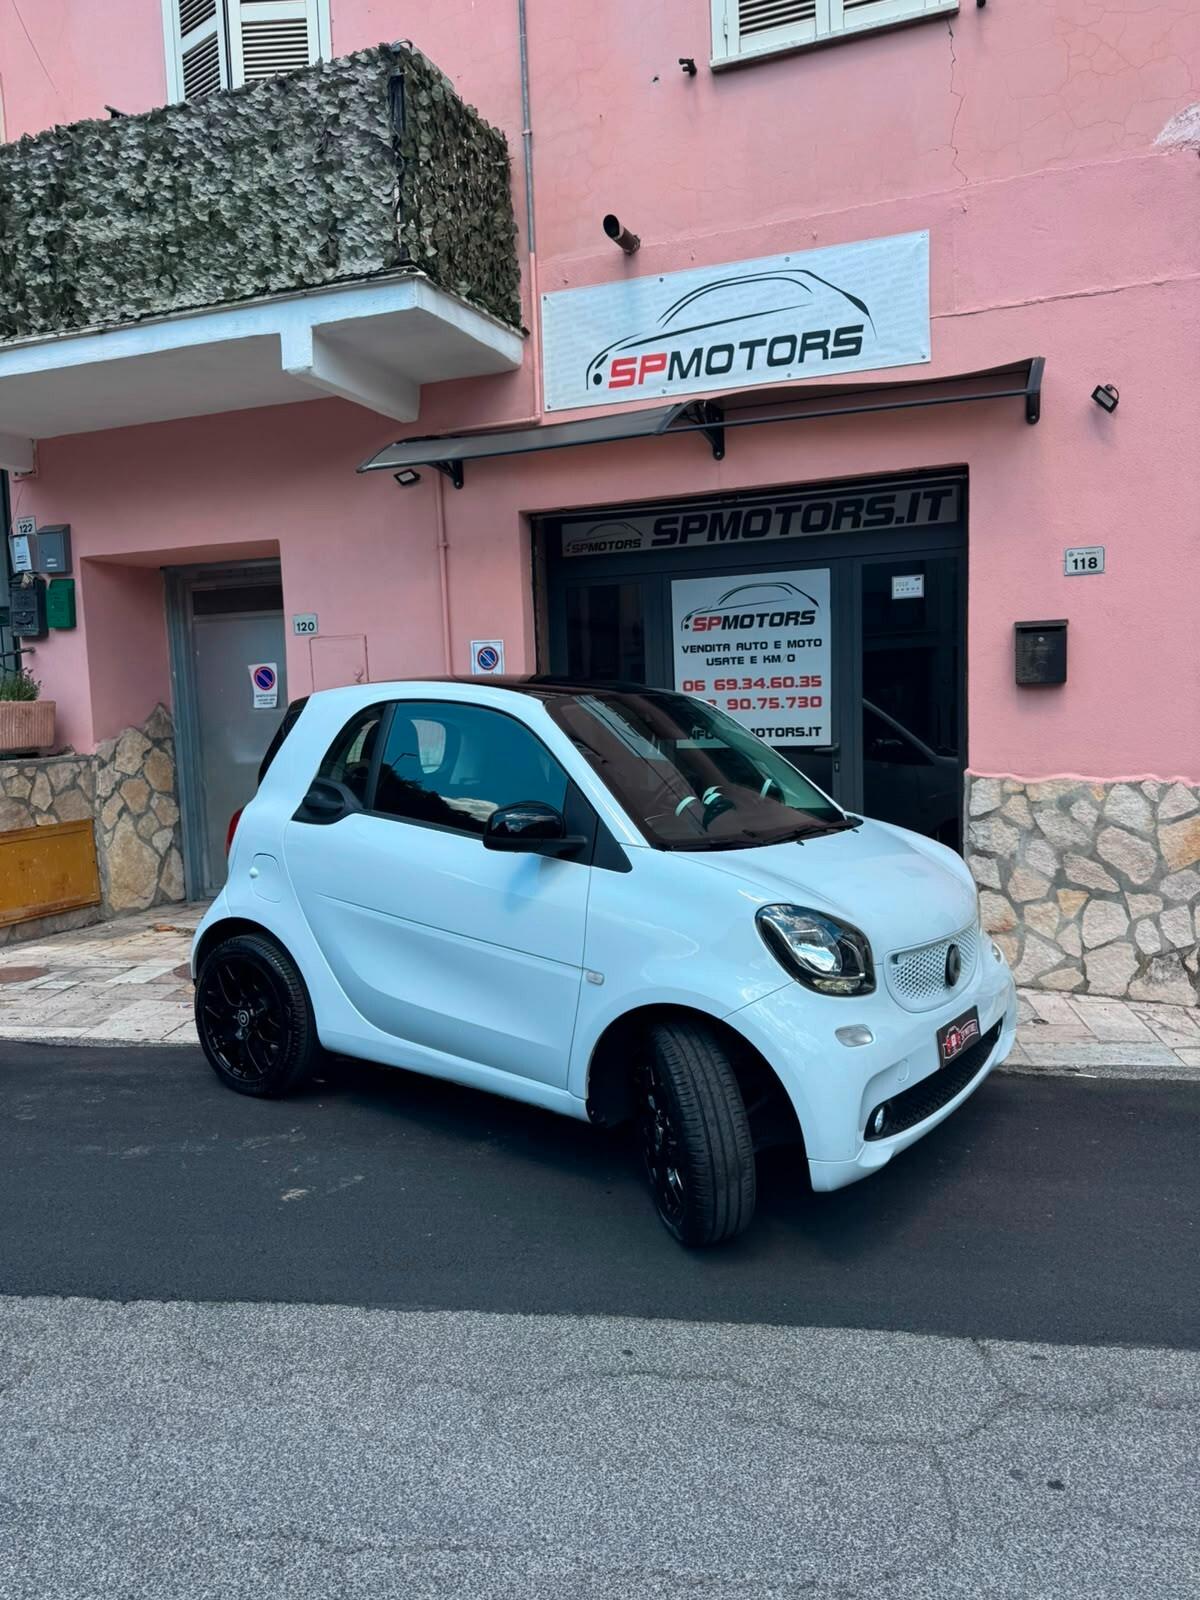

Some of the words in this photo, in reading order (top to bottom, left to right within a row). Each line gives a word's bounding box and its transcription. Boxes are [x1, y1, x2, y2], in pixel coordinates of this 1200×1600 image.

[608, 324, 864, 389] SPMOTORS
[651, 489, 953, 547] SPMOTORS.IT
[19, 523, 33, 533] 122
[571, 538, 641, 554] SPMOTORS
[1072, 557, 1098, 570] 118
[296, 621, 315, 632] 120
[692, 610, 816, 632] SPMOTORS
[681, 643, 730, 654] VENDITA
[736, 641, 768, 651] AUTO
[774, 640, 781, 649] E
[787, 638, 822, 648] MOTO
[706, 656, 745, 666] USATE
[750, 655, 757, 664] E
[682, 680, 705, 692] 06
[714, 675, 822, 691] 69.34.60.35
[727, 696, 822, 711] 90.75.730
